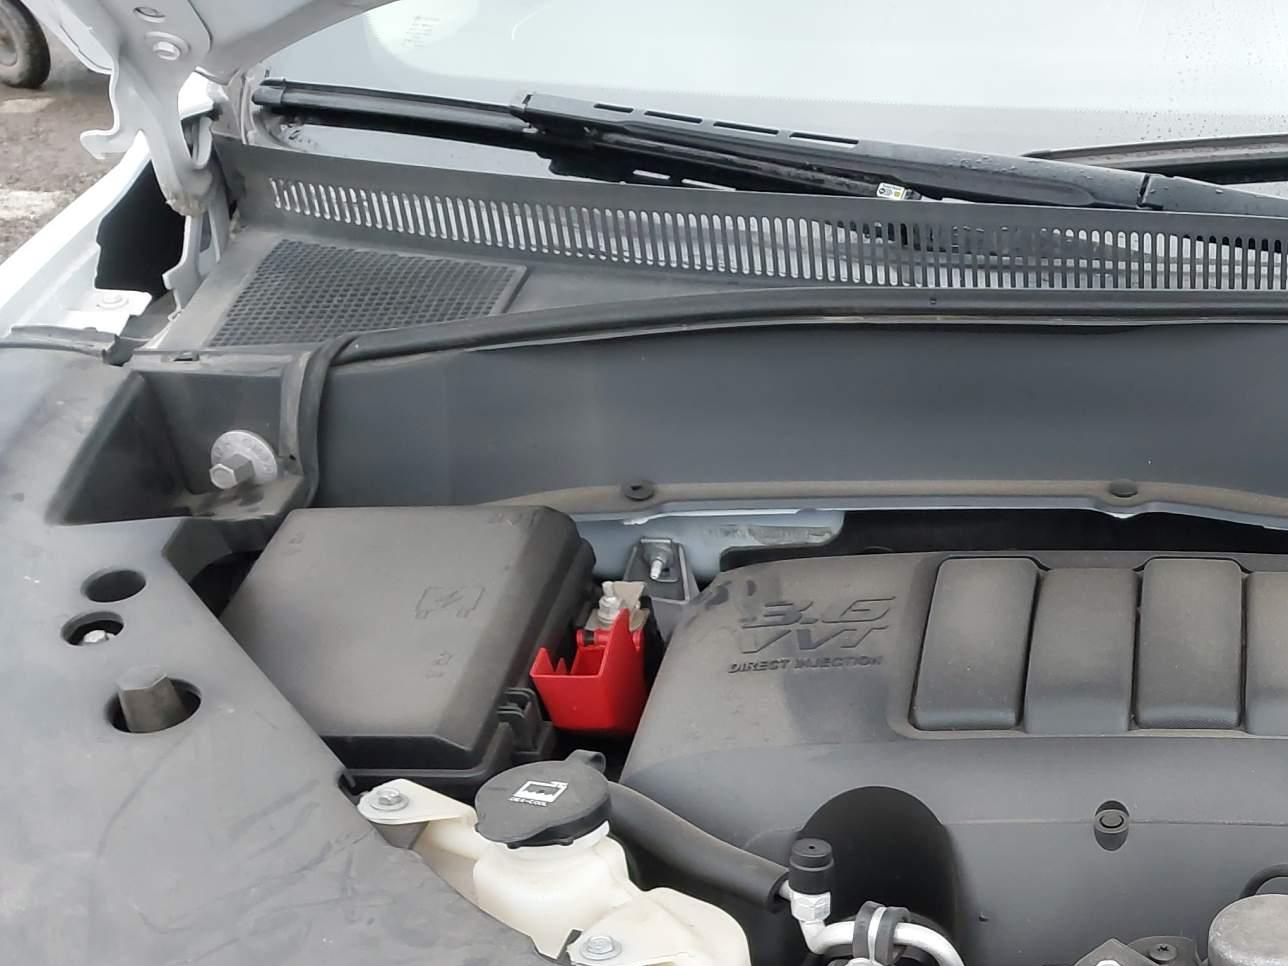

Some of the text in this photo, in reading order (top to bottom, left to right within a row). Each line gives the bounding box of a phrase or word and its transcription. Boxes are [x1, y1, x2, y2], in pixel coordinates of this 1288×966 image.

[739, 596, 897, 629] 3.6
[739, 625, 888, 655] VVT
[728, 655, 882, 674] DIRECT INJECTION
